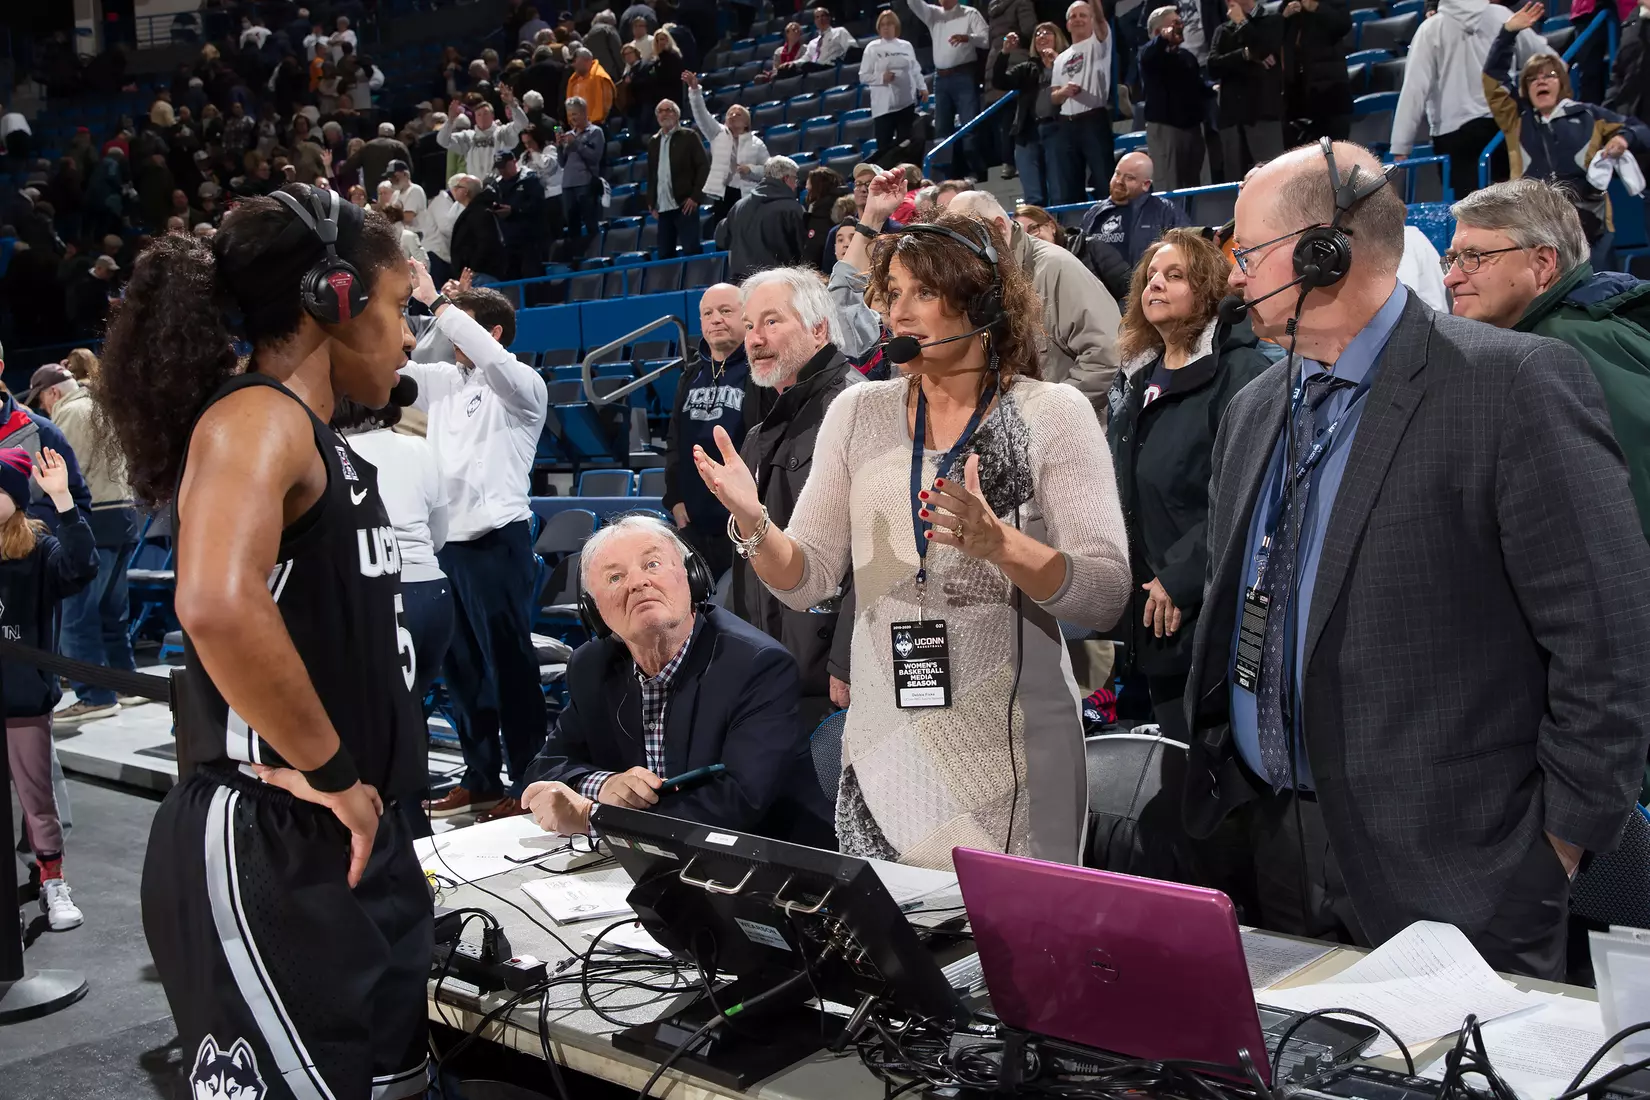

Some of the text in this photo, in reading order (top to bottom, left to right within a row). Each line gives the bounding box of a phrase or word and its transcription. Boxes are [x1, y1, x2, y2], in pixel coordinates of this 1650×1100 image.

[394, 593, 417, 692] 5
[914, 637, 944, 646] UCONN
[904, 661, 938, 669] WOMEN'S
[899, 668, 944, 676] BASKETBALL
